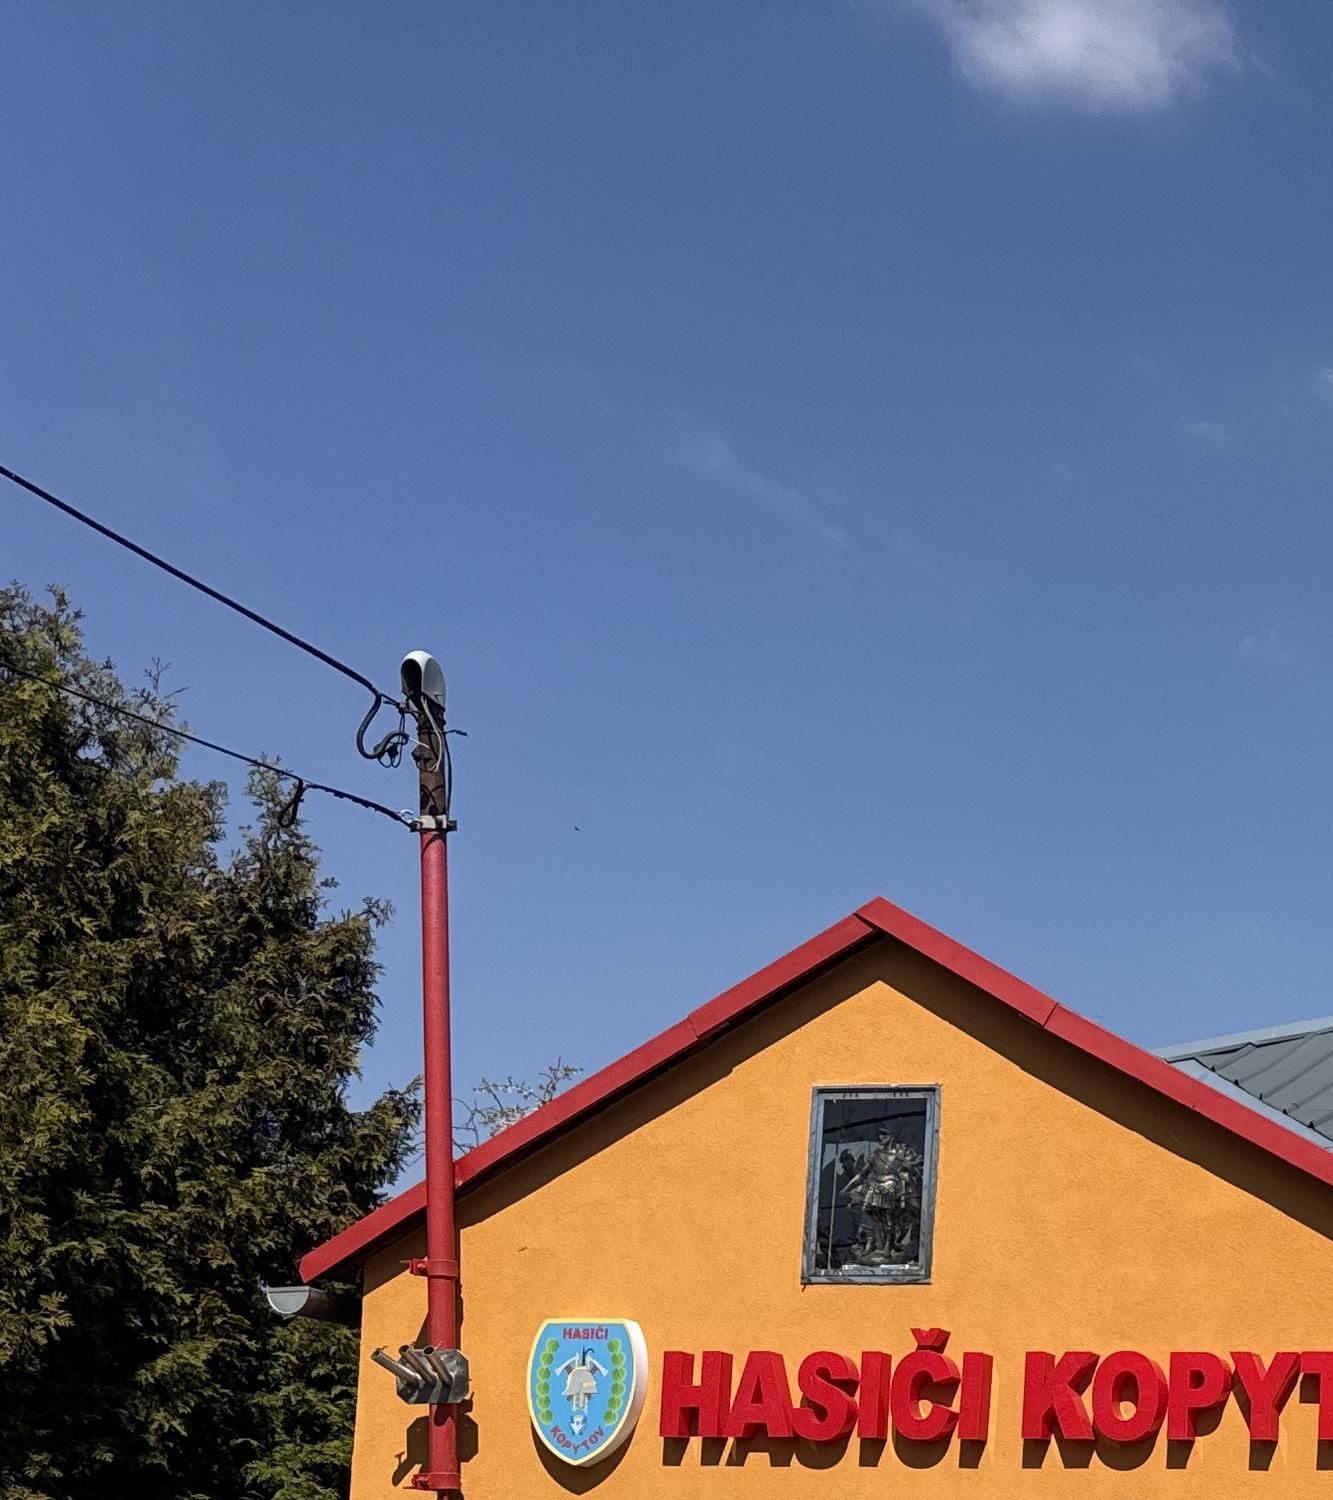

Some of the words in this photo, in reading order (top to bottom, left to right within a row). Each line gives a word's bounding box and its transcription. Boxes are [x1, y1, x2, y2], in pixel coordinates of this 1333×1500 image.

[562, 1326, 609, 1340] HASIČI
[659, 1328, 993, 1444] HASIČI
[550, 1424, 605, 1454] KOPYTOV
